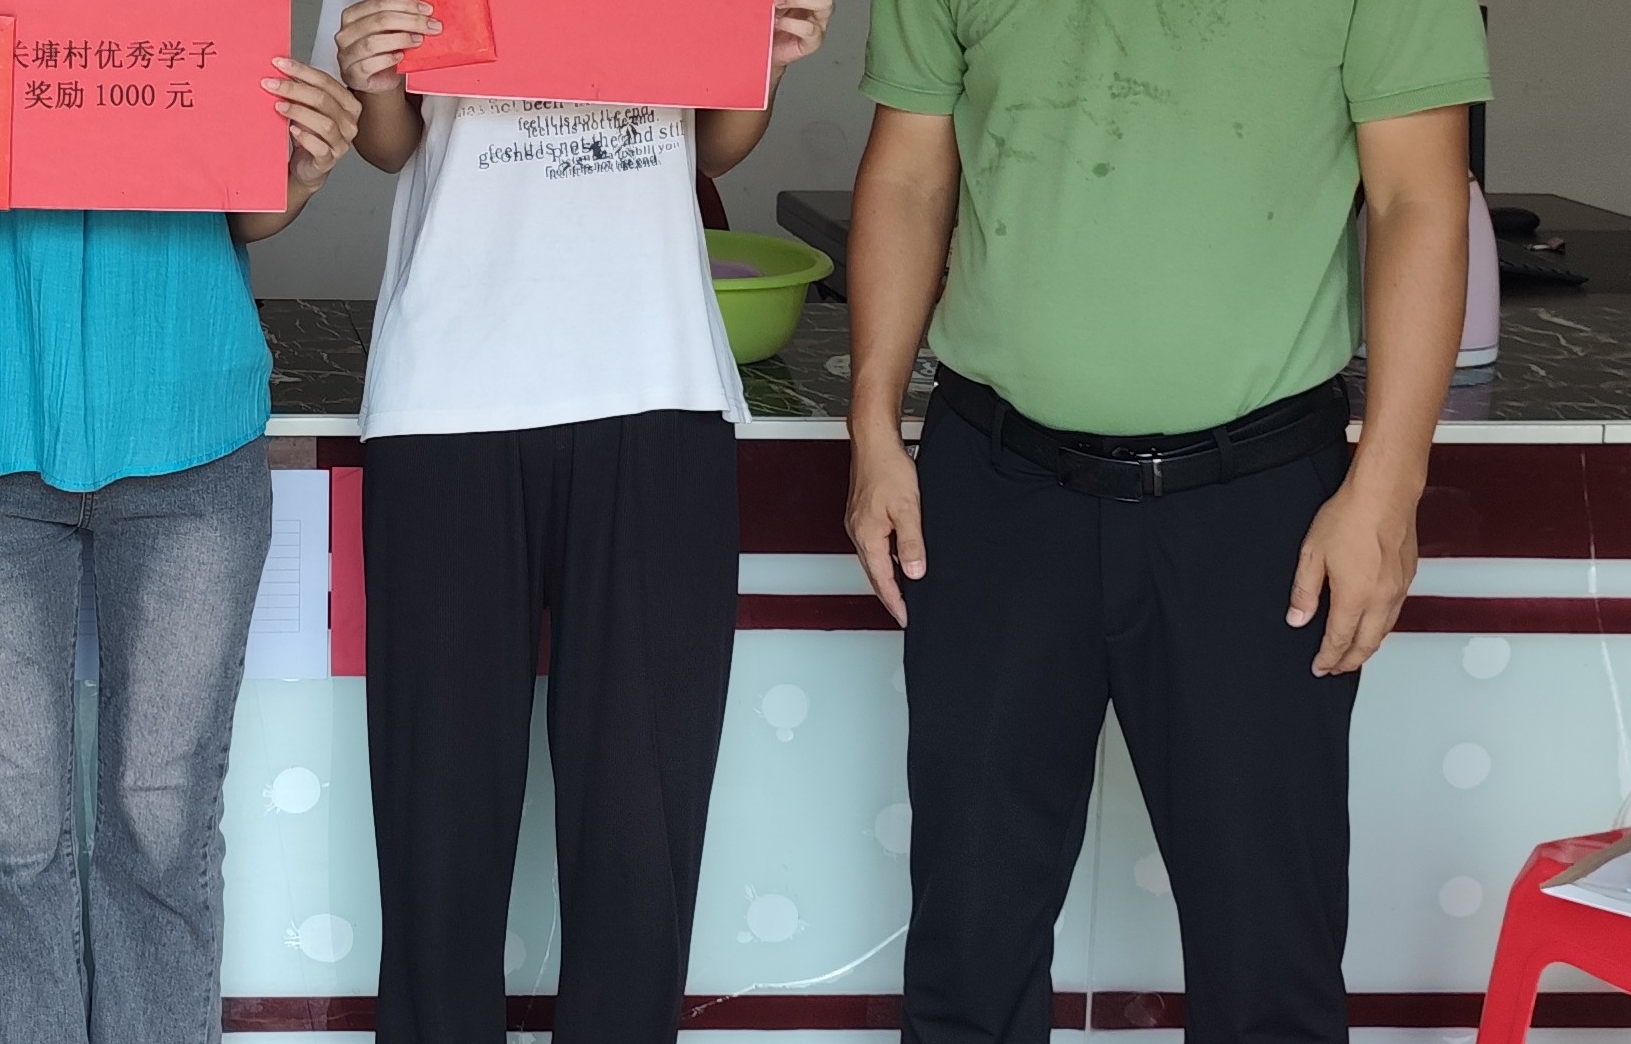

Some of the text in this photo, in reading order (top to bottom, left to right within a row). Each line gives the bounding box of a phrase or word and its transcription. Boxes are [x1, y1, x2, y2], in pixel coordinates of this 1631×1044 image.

[23, 79, 195, 110] 奖励 1000 元
